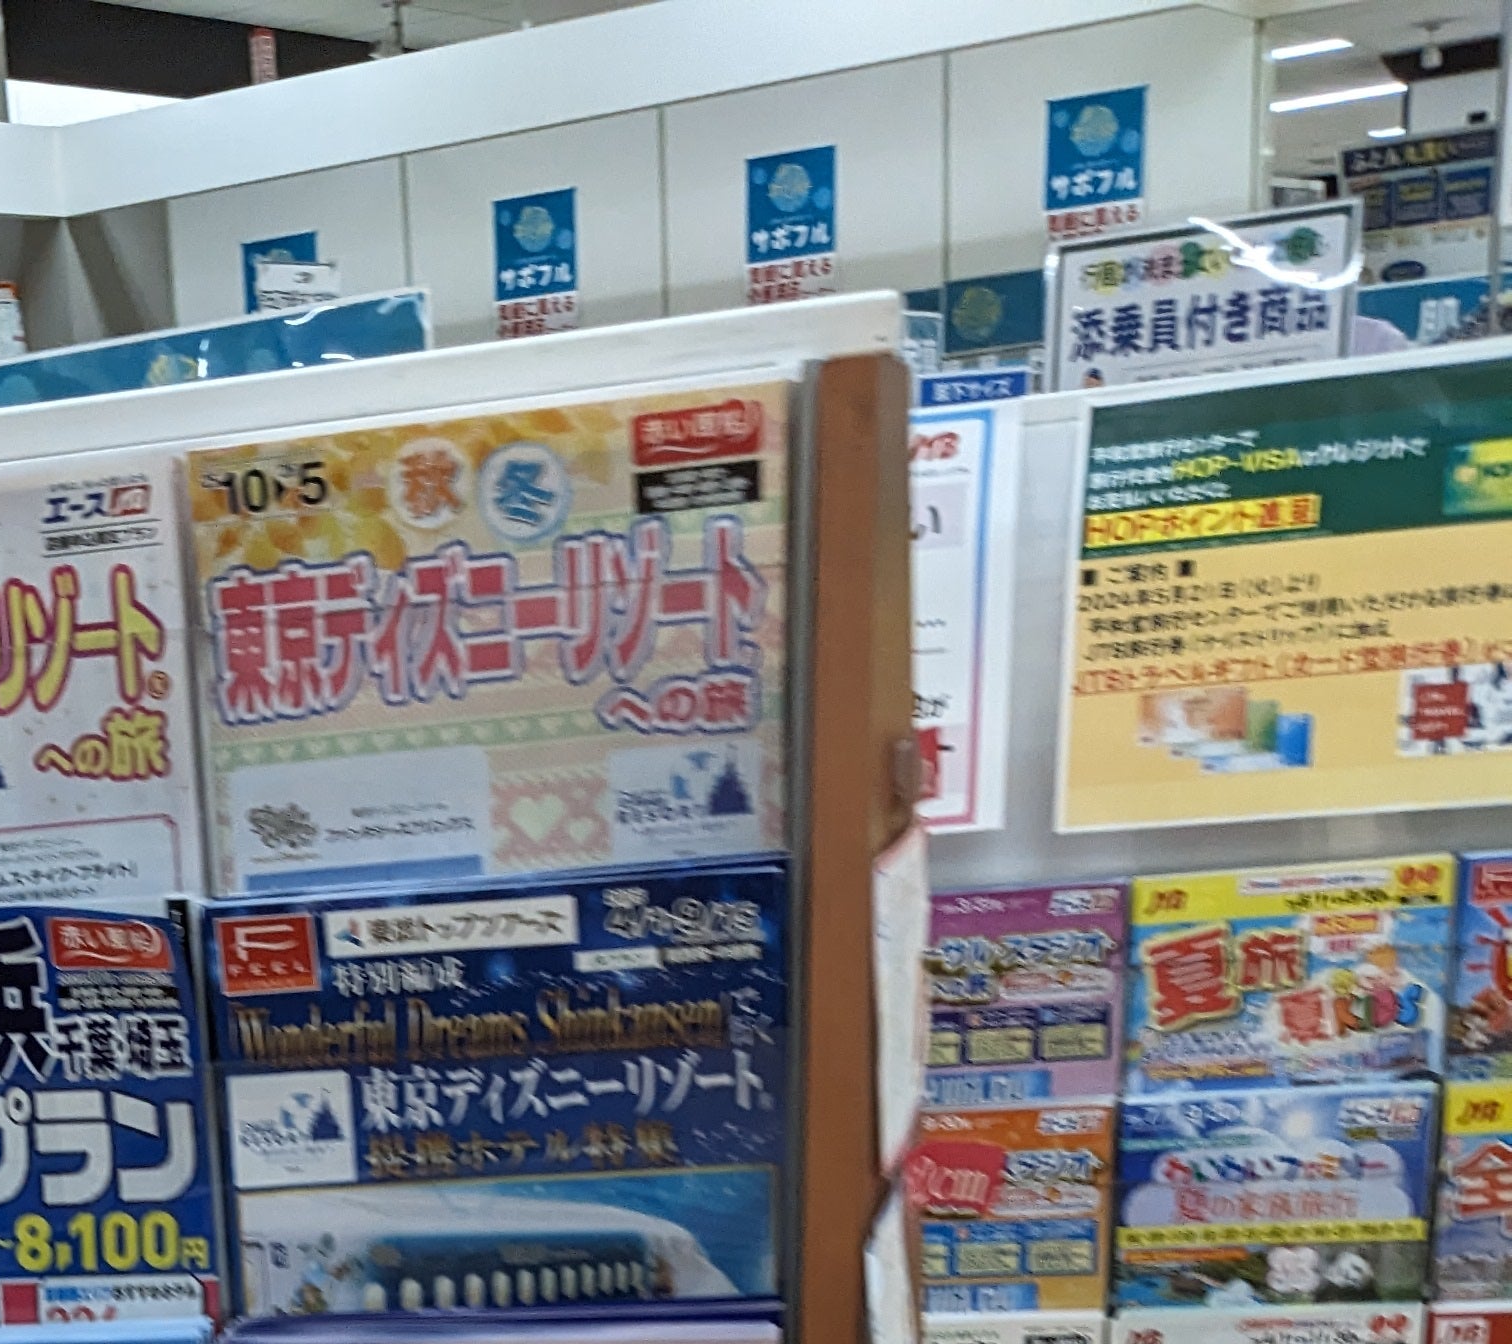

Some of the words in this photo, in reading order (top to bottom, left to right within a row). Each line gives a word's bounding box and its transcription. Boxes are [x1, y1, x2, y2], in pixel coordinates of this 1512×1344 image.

[1050, 167, 1137, 200] サポフル
[751, 226, 831, 255] サポフル
[1070, 288, 1330, 362] 添乗員付き商品
[400, 449, 467, 521] 秋
[493, 457, 556, 528] 冬
[210, 516, 766, 725] 東京ディズニーリゾート
[598, 667, 761, 735] への旅
[34, 707, 169, 781] への旅
[360, 1049, 763, 1132] 東京ディズニーリゾート
